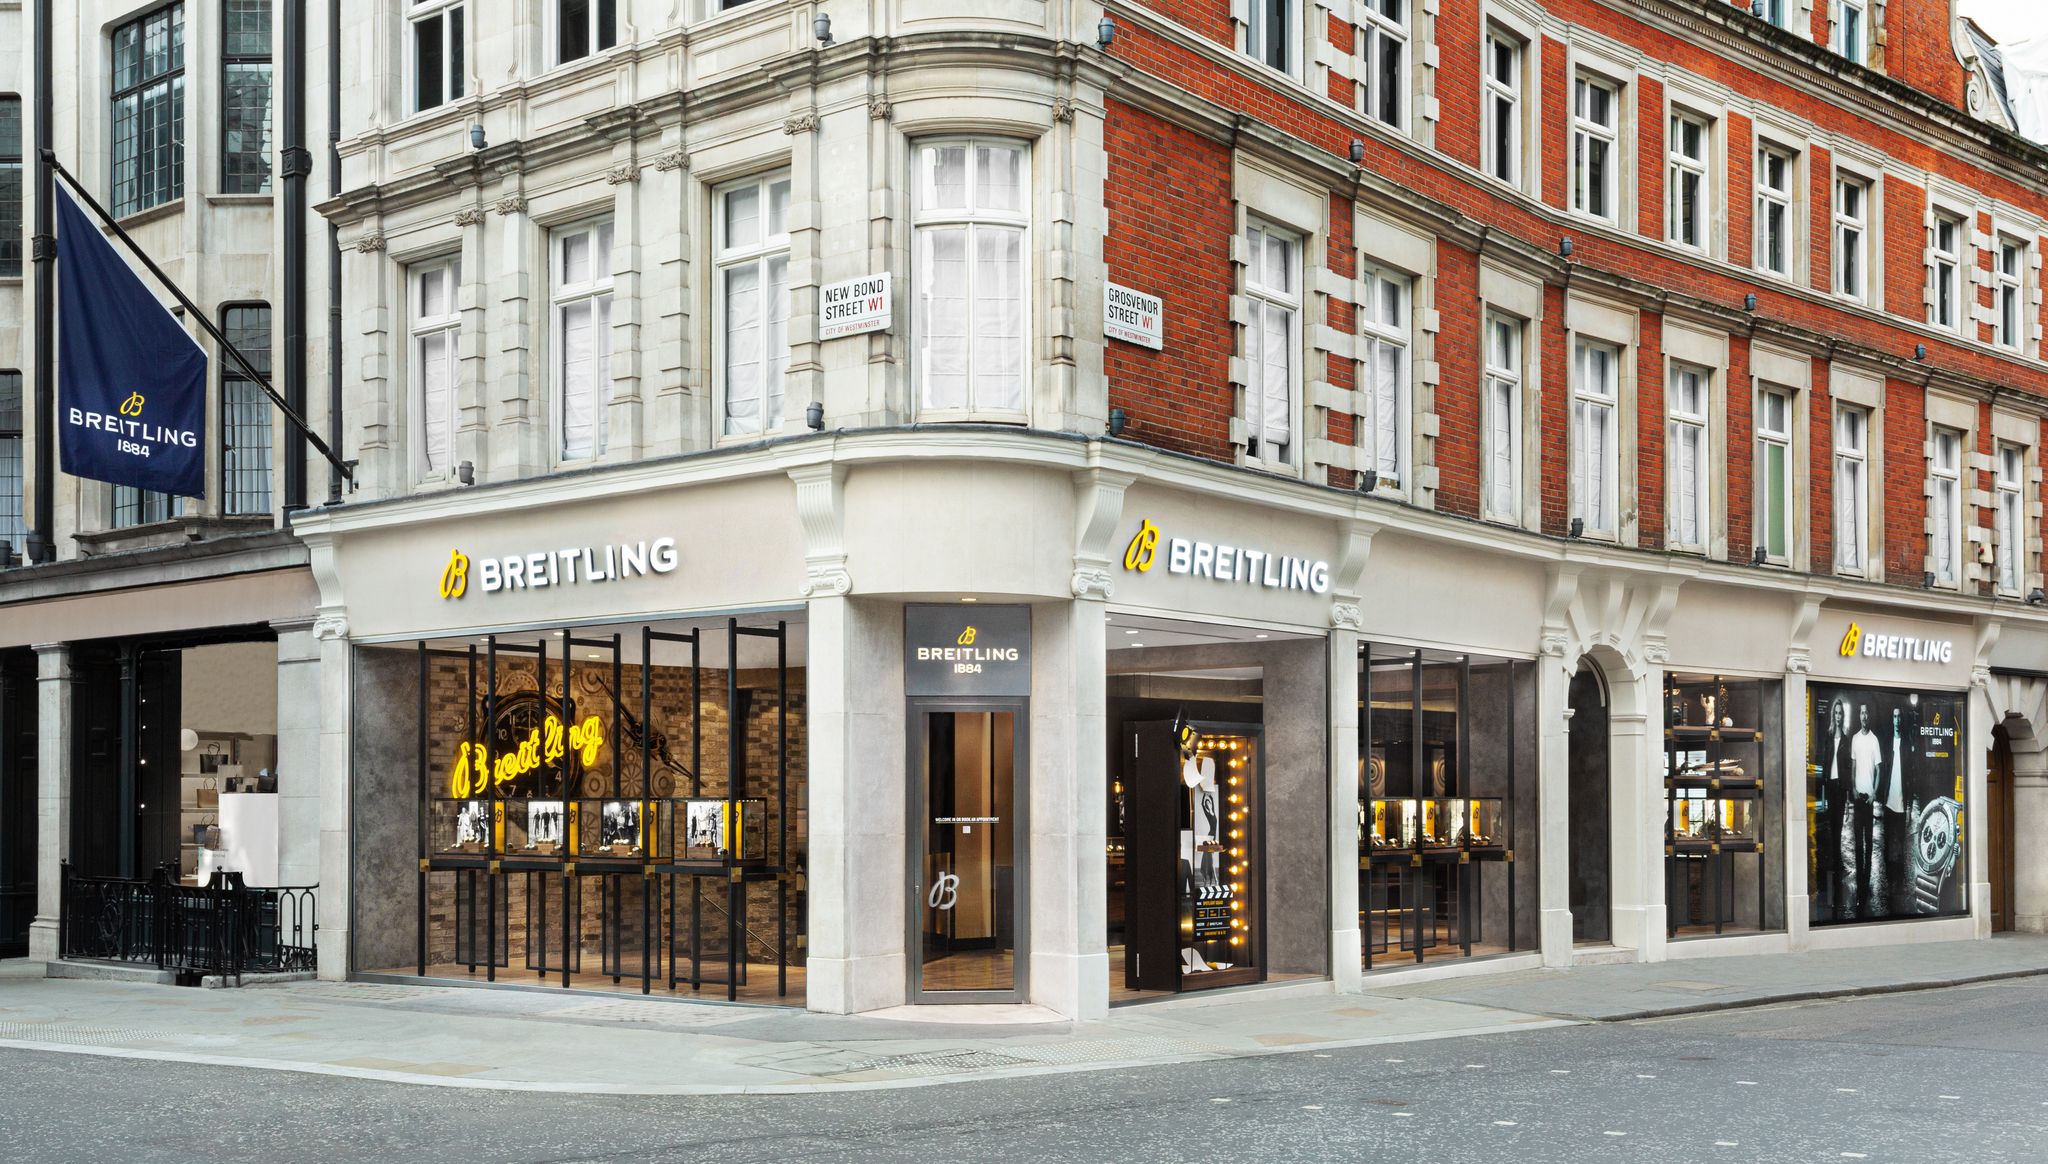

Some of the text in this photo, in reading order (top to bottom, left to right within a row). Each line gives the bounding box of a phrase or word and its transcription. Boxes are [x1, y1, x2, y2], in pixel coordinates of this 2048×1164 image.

[826, 279, 884, 303] NEW BOND
[1109, 288, 1158, 315] GROSVENOR
[826, 296, 883, 320] STREET W1
[1109, 305, 1153, 330] STREET W1
[826, 326, 836, 335] CITY
[845, 320, 880, 331] WESTMINSTER
[70, 407, 197, 447] BREITLING
[118, 439, 150, 457] 1884
[480, 537, 678, 591] BREITLING
[1169, 538, 1329, 593] BREITLING
[917, 647, 1019, 661] BREITLING
[1864, 633, 1952, 663] BREITLING
[954, 663, 982, 674] 1884
[1920, 726, 1954, 737] BREITLING
